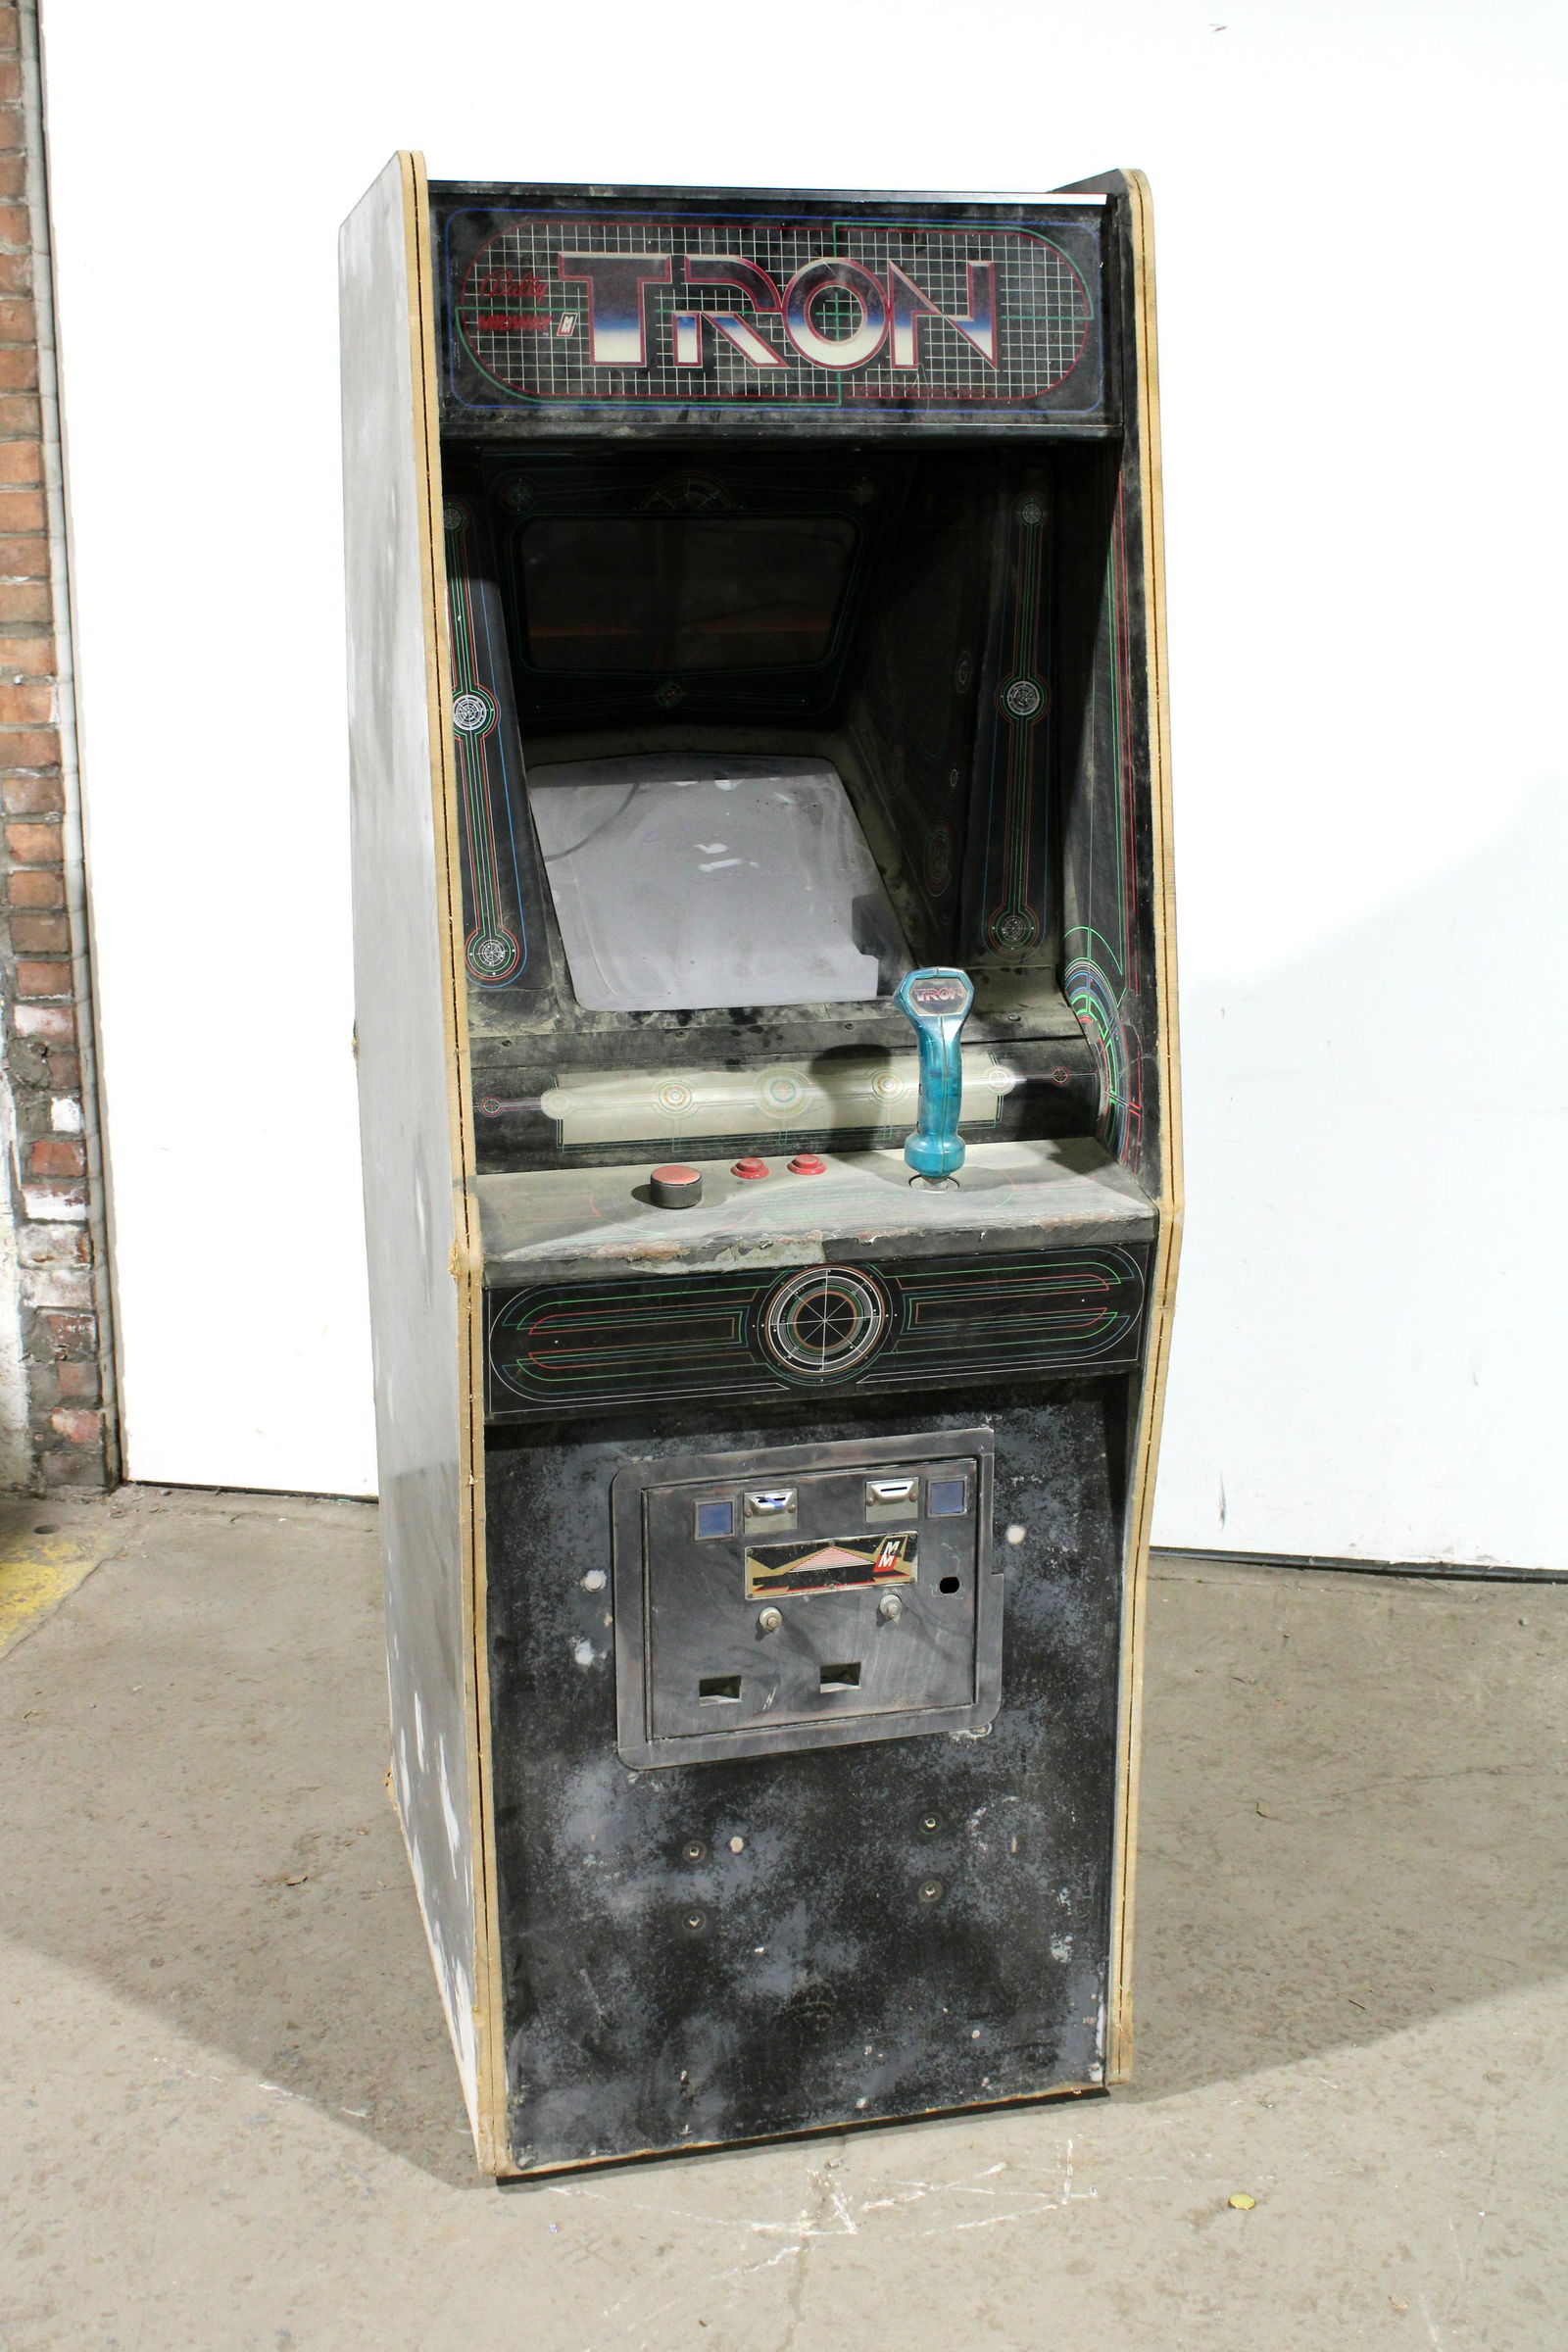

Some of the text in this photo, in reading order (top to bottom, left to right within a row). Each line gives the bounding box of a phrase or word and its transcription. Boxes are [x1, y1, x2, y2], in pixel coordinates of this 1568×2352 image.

[479, 269, 549, 304] Bally
[476, 315, 552, 331] MIDWAY
[558, 252, 998, 370] TRON
[913, 987, 964, 1002] TRON
